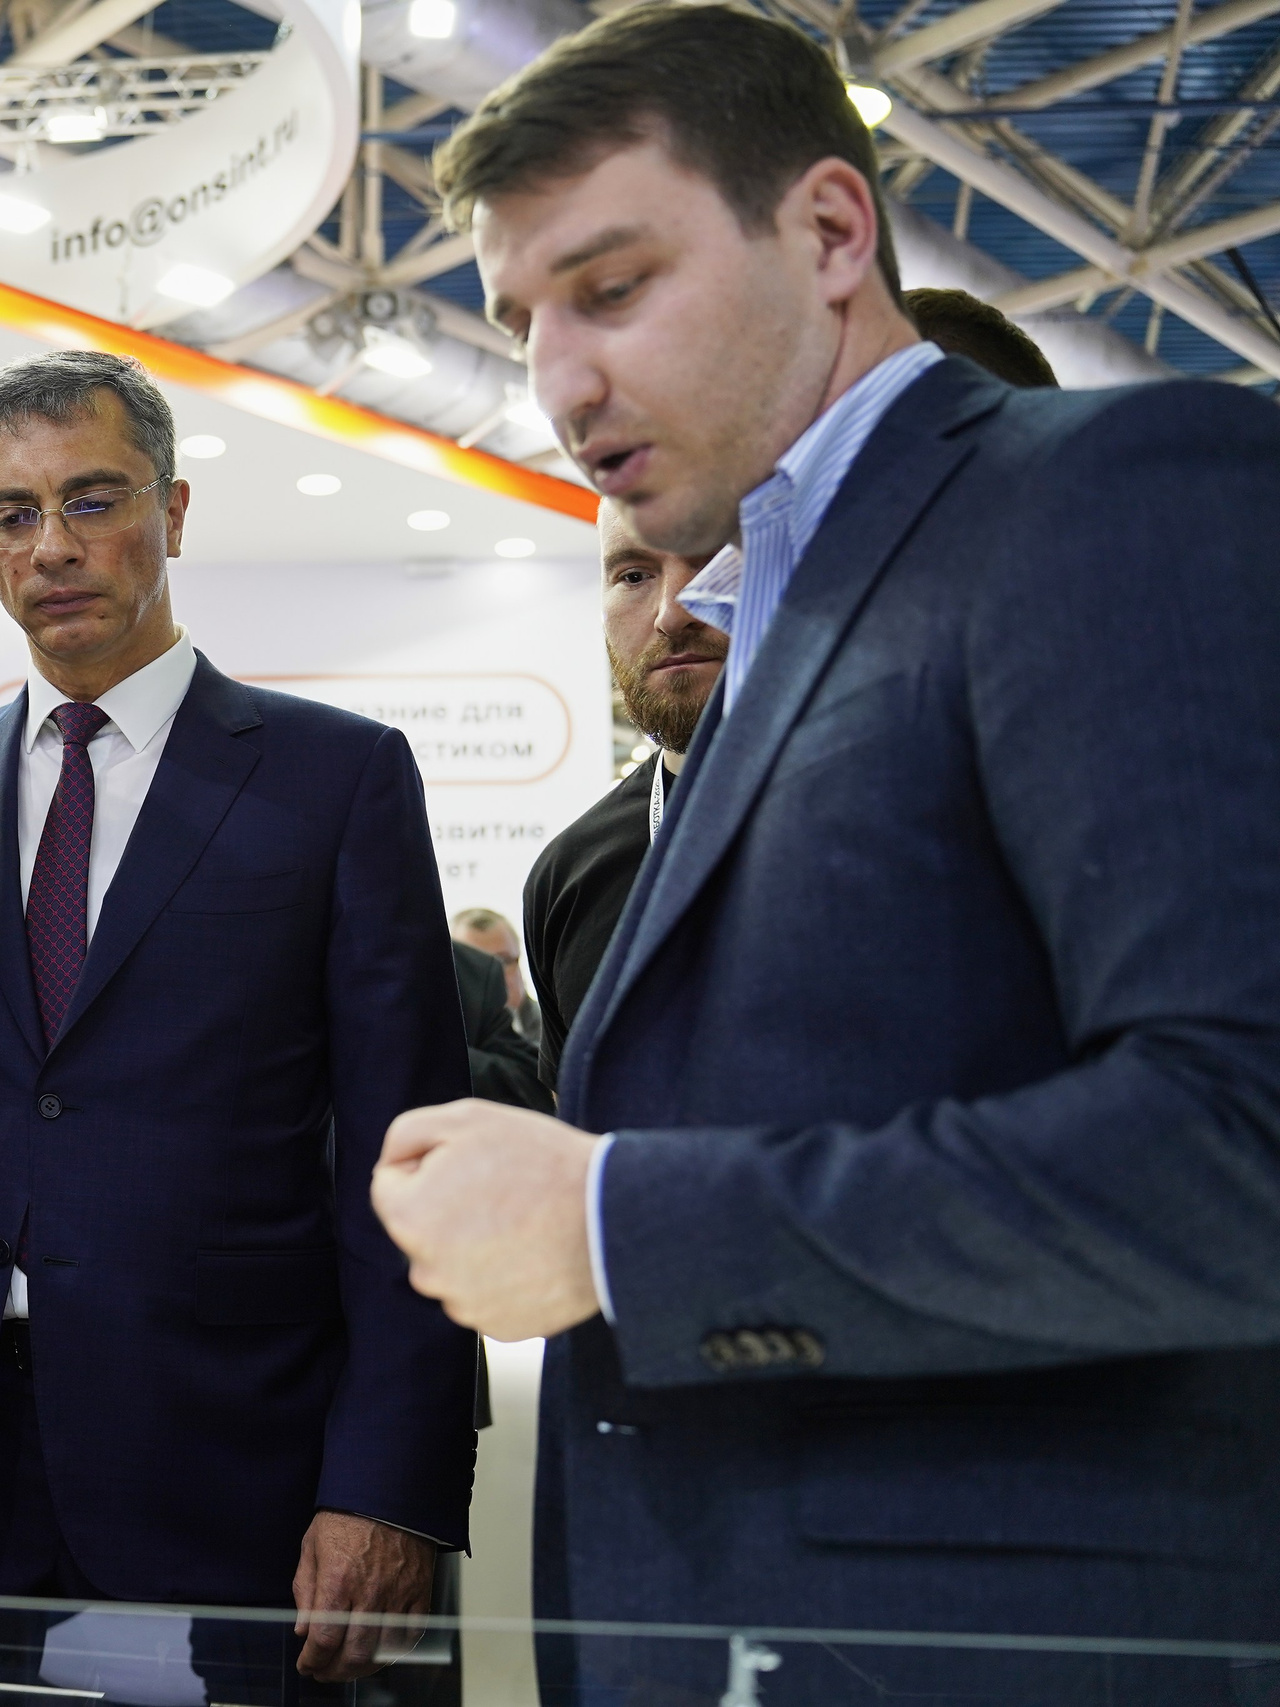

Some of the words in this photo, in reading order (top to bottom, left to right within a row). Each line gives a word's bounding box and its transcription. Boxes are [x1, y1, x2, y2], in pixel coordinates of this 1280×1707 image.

[50, 107, 299, 265] info@onsint.ru
[352, 703, 448, 721] ание
[460, 703, 524, 724] для
[414, 741, 534, 759] стиком
[434, 821, 547, 840] звитие
